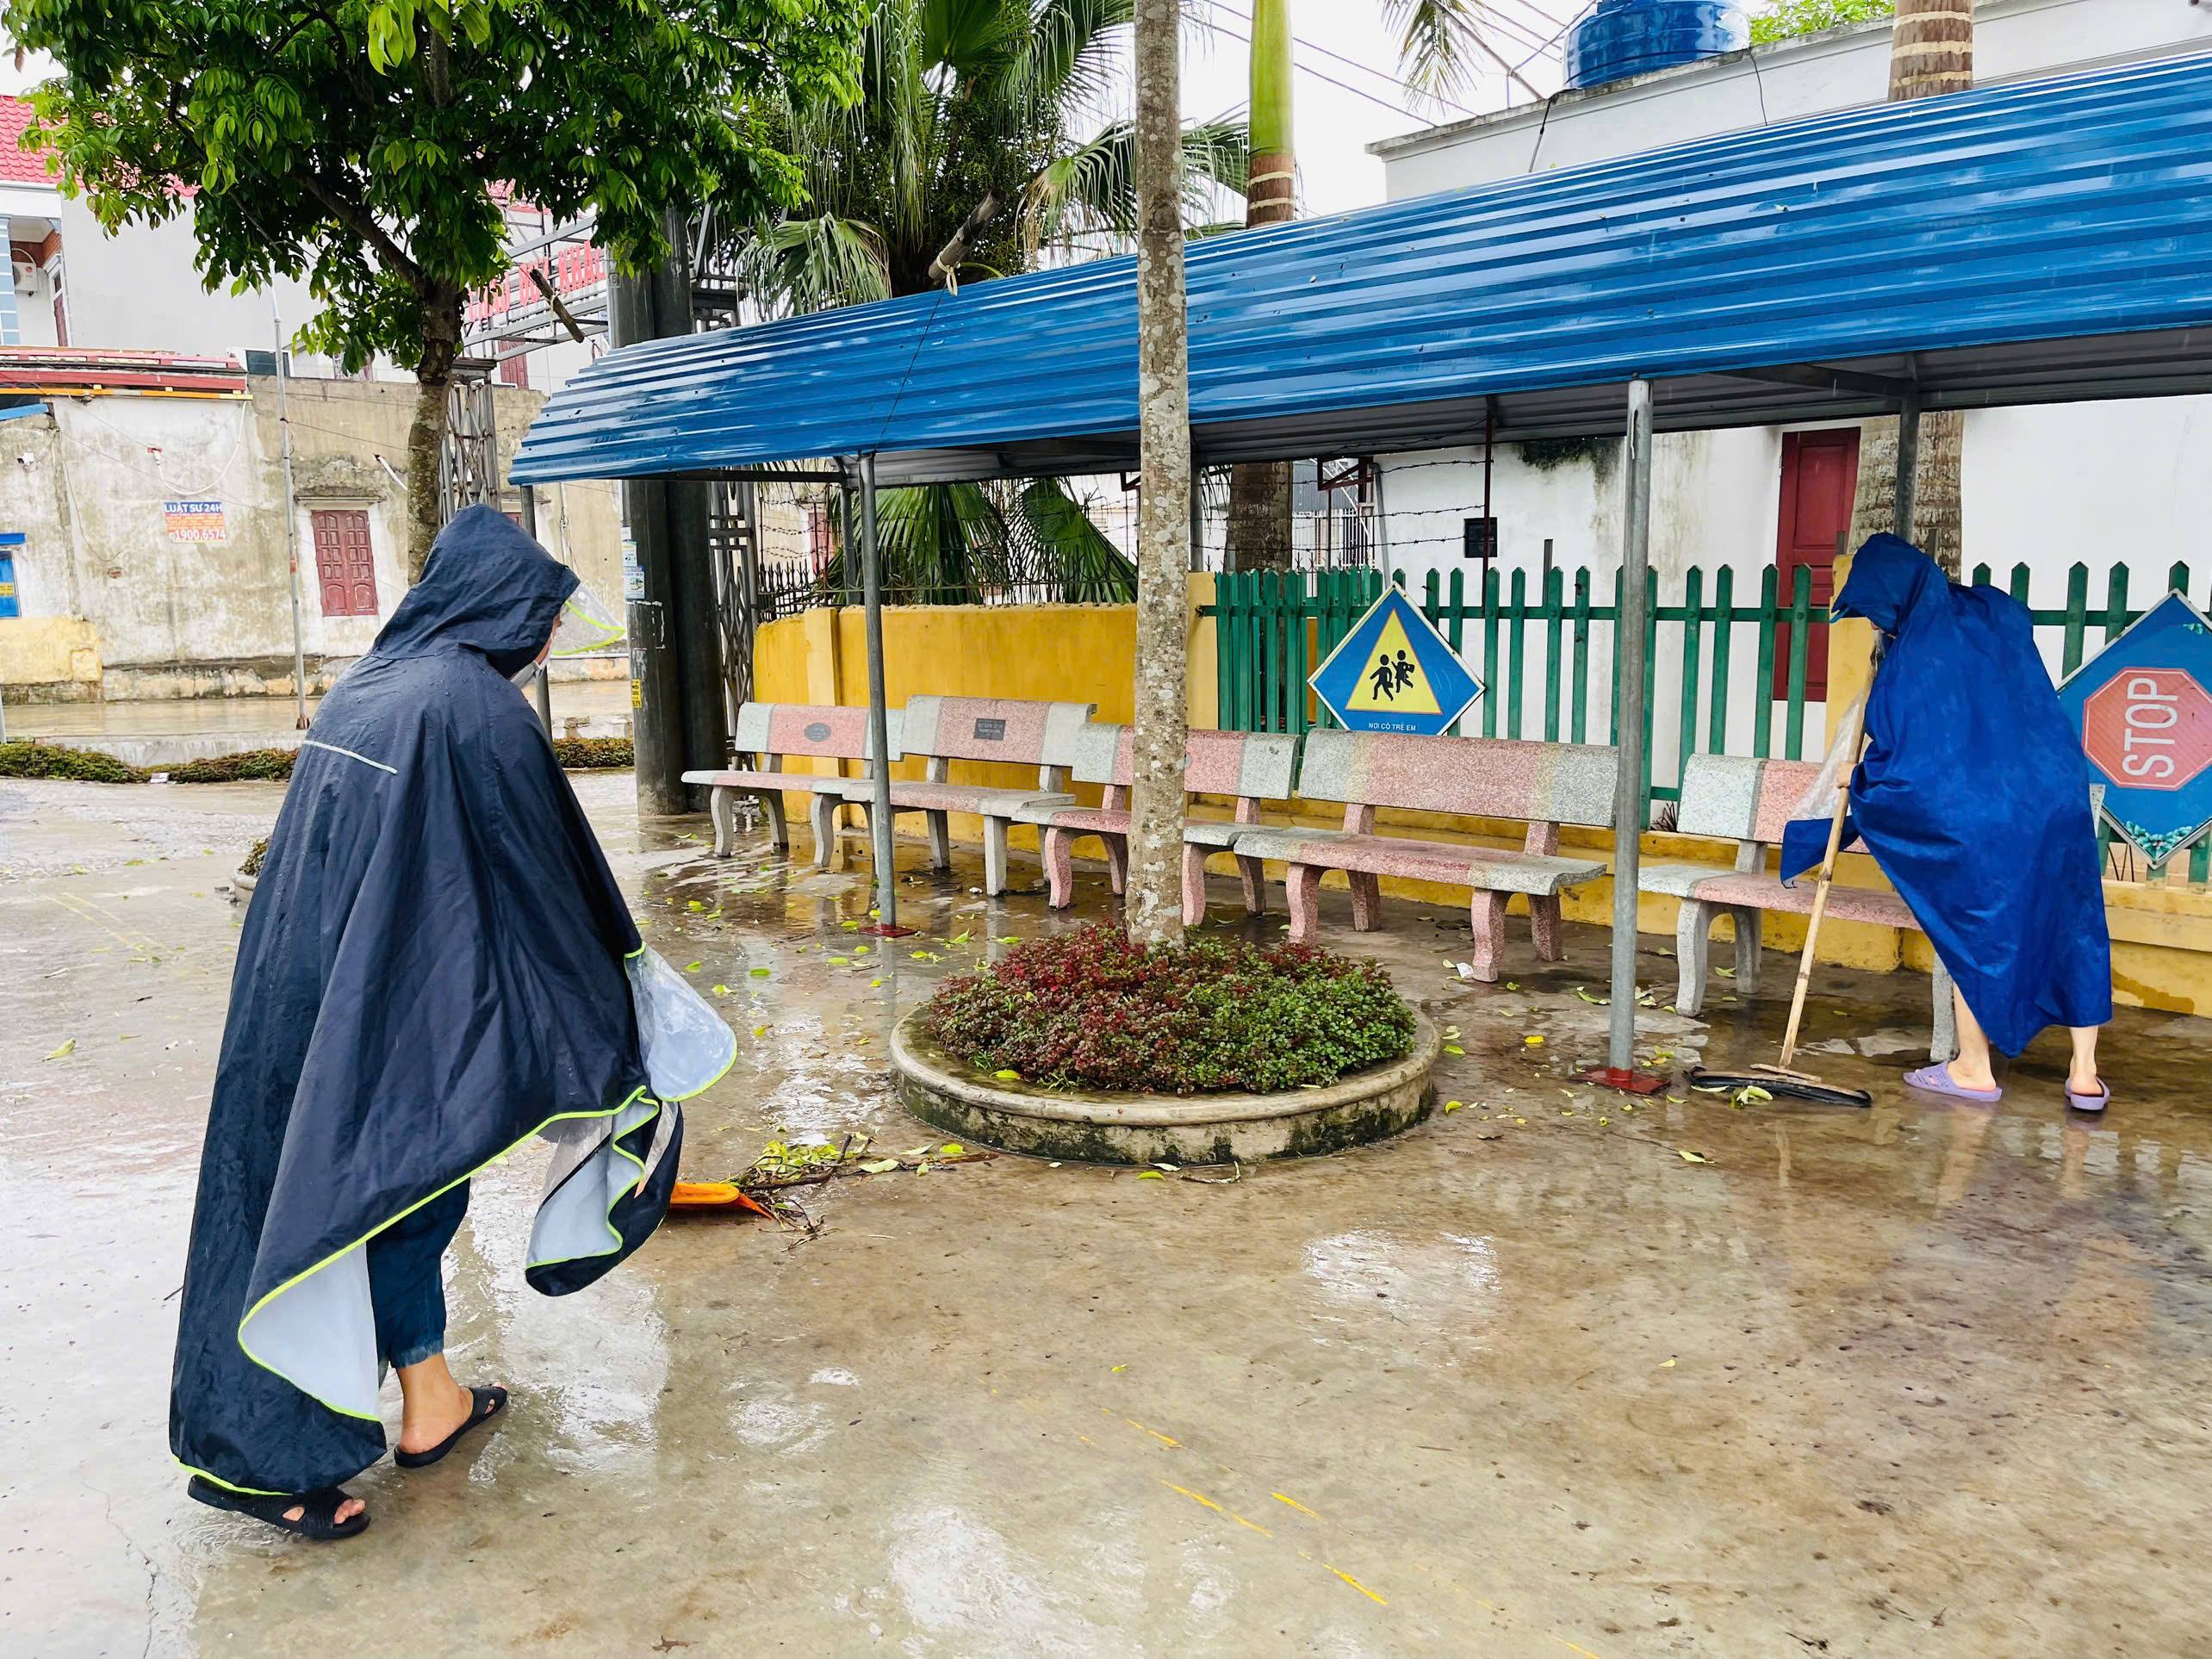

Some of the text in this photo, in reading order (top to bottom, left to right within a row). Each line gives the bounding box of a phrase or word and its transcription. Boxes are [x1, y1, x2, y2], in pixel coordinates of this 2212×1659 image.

[165, 501, 223, 513] LUẬT SƯ 24H
[1392, 723, 1405, 731] TRẺ
[2122, 677, 2178, 779] STOP
